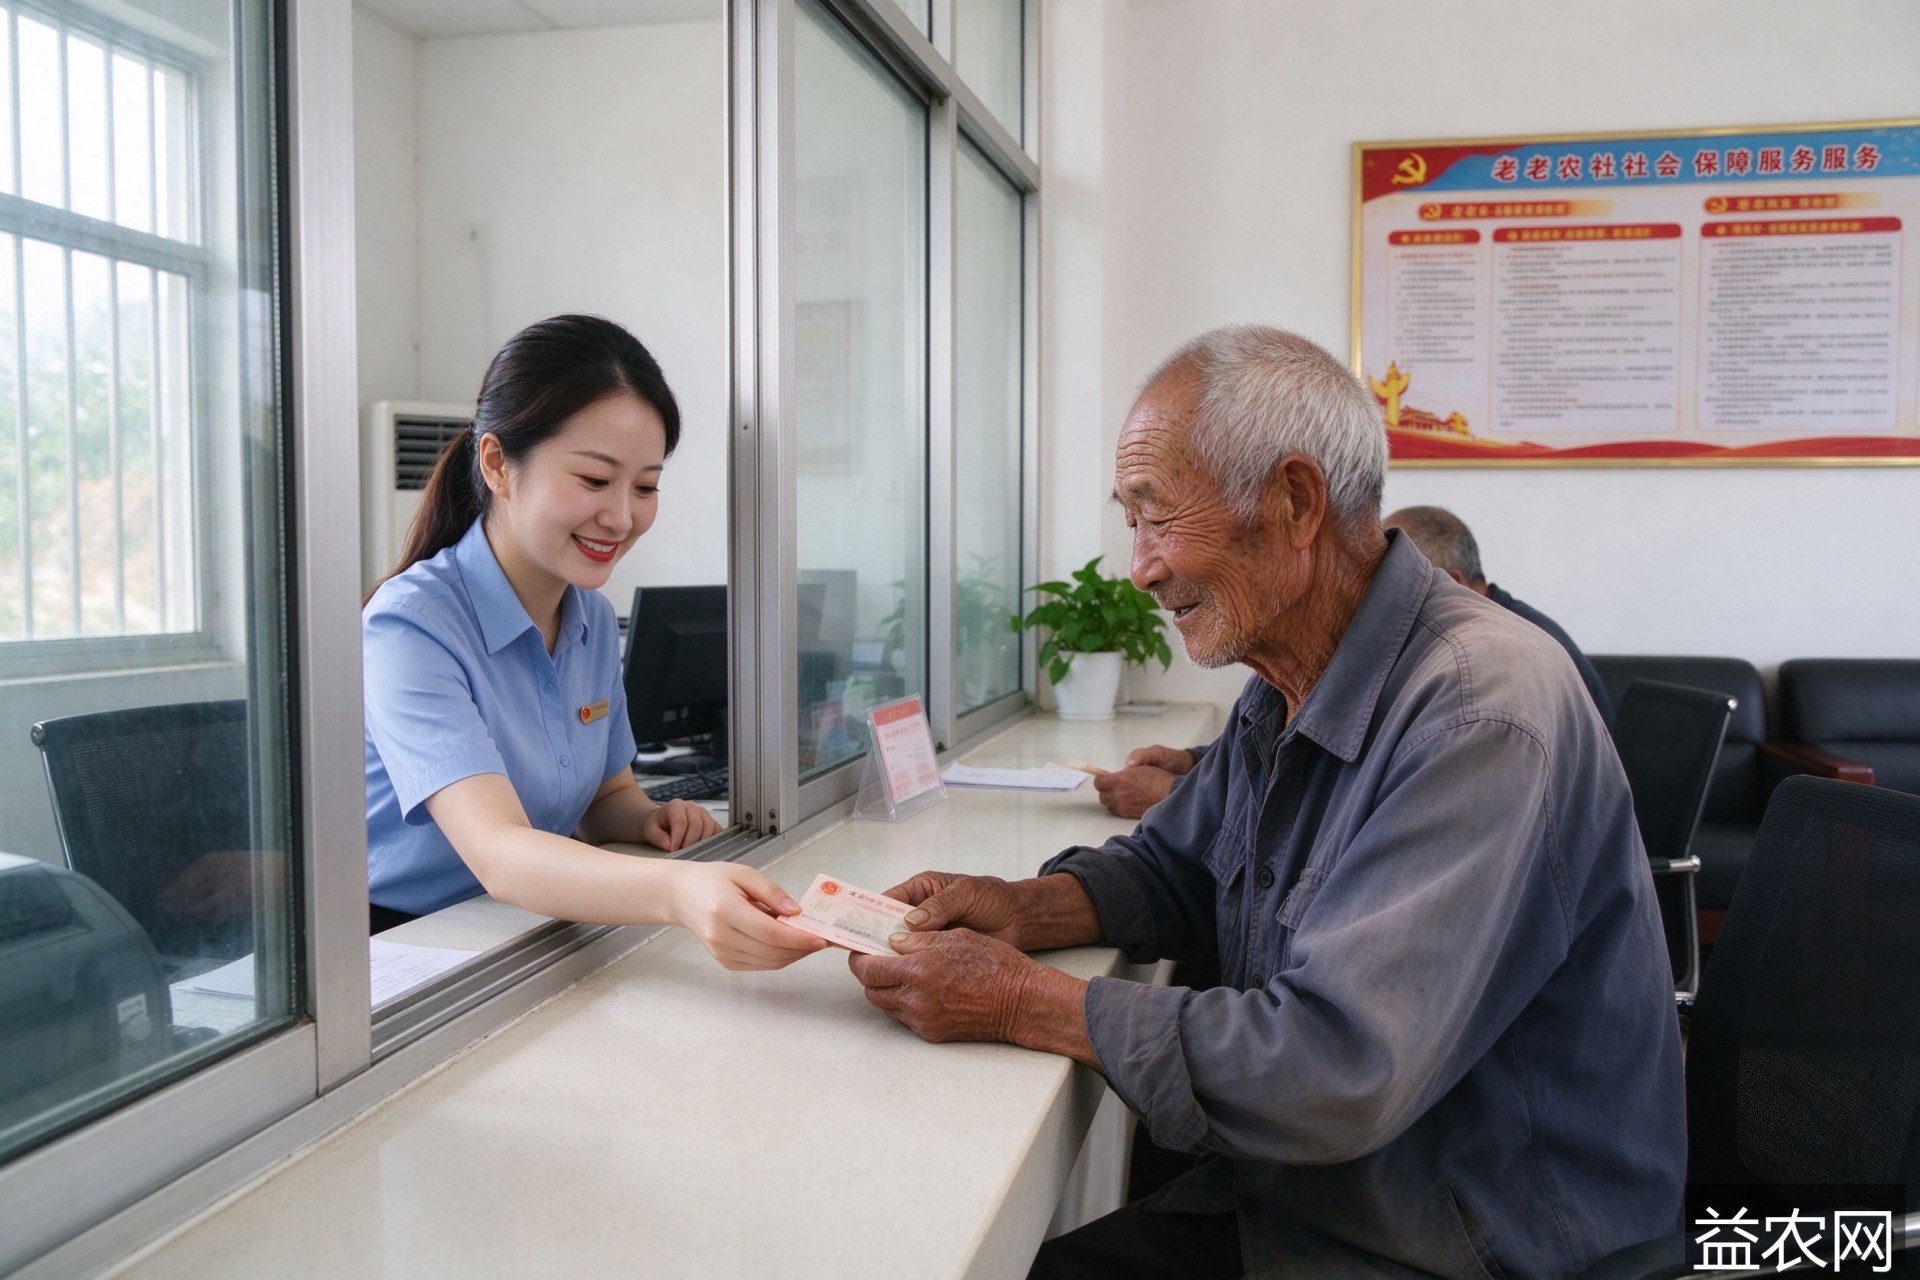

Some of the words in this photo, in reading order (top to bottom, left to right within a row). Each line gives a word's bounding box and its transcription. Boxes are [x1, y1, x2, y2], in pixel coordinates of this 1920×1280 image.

[1694, 145, 1880, 176] 保障服务服务
